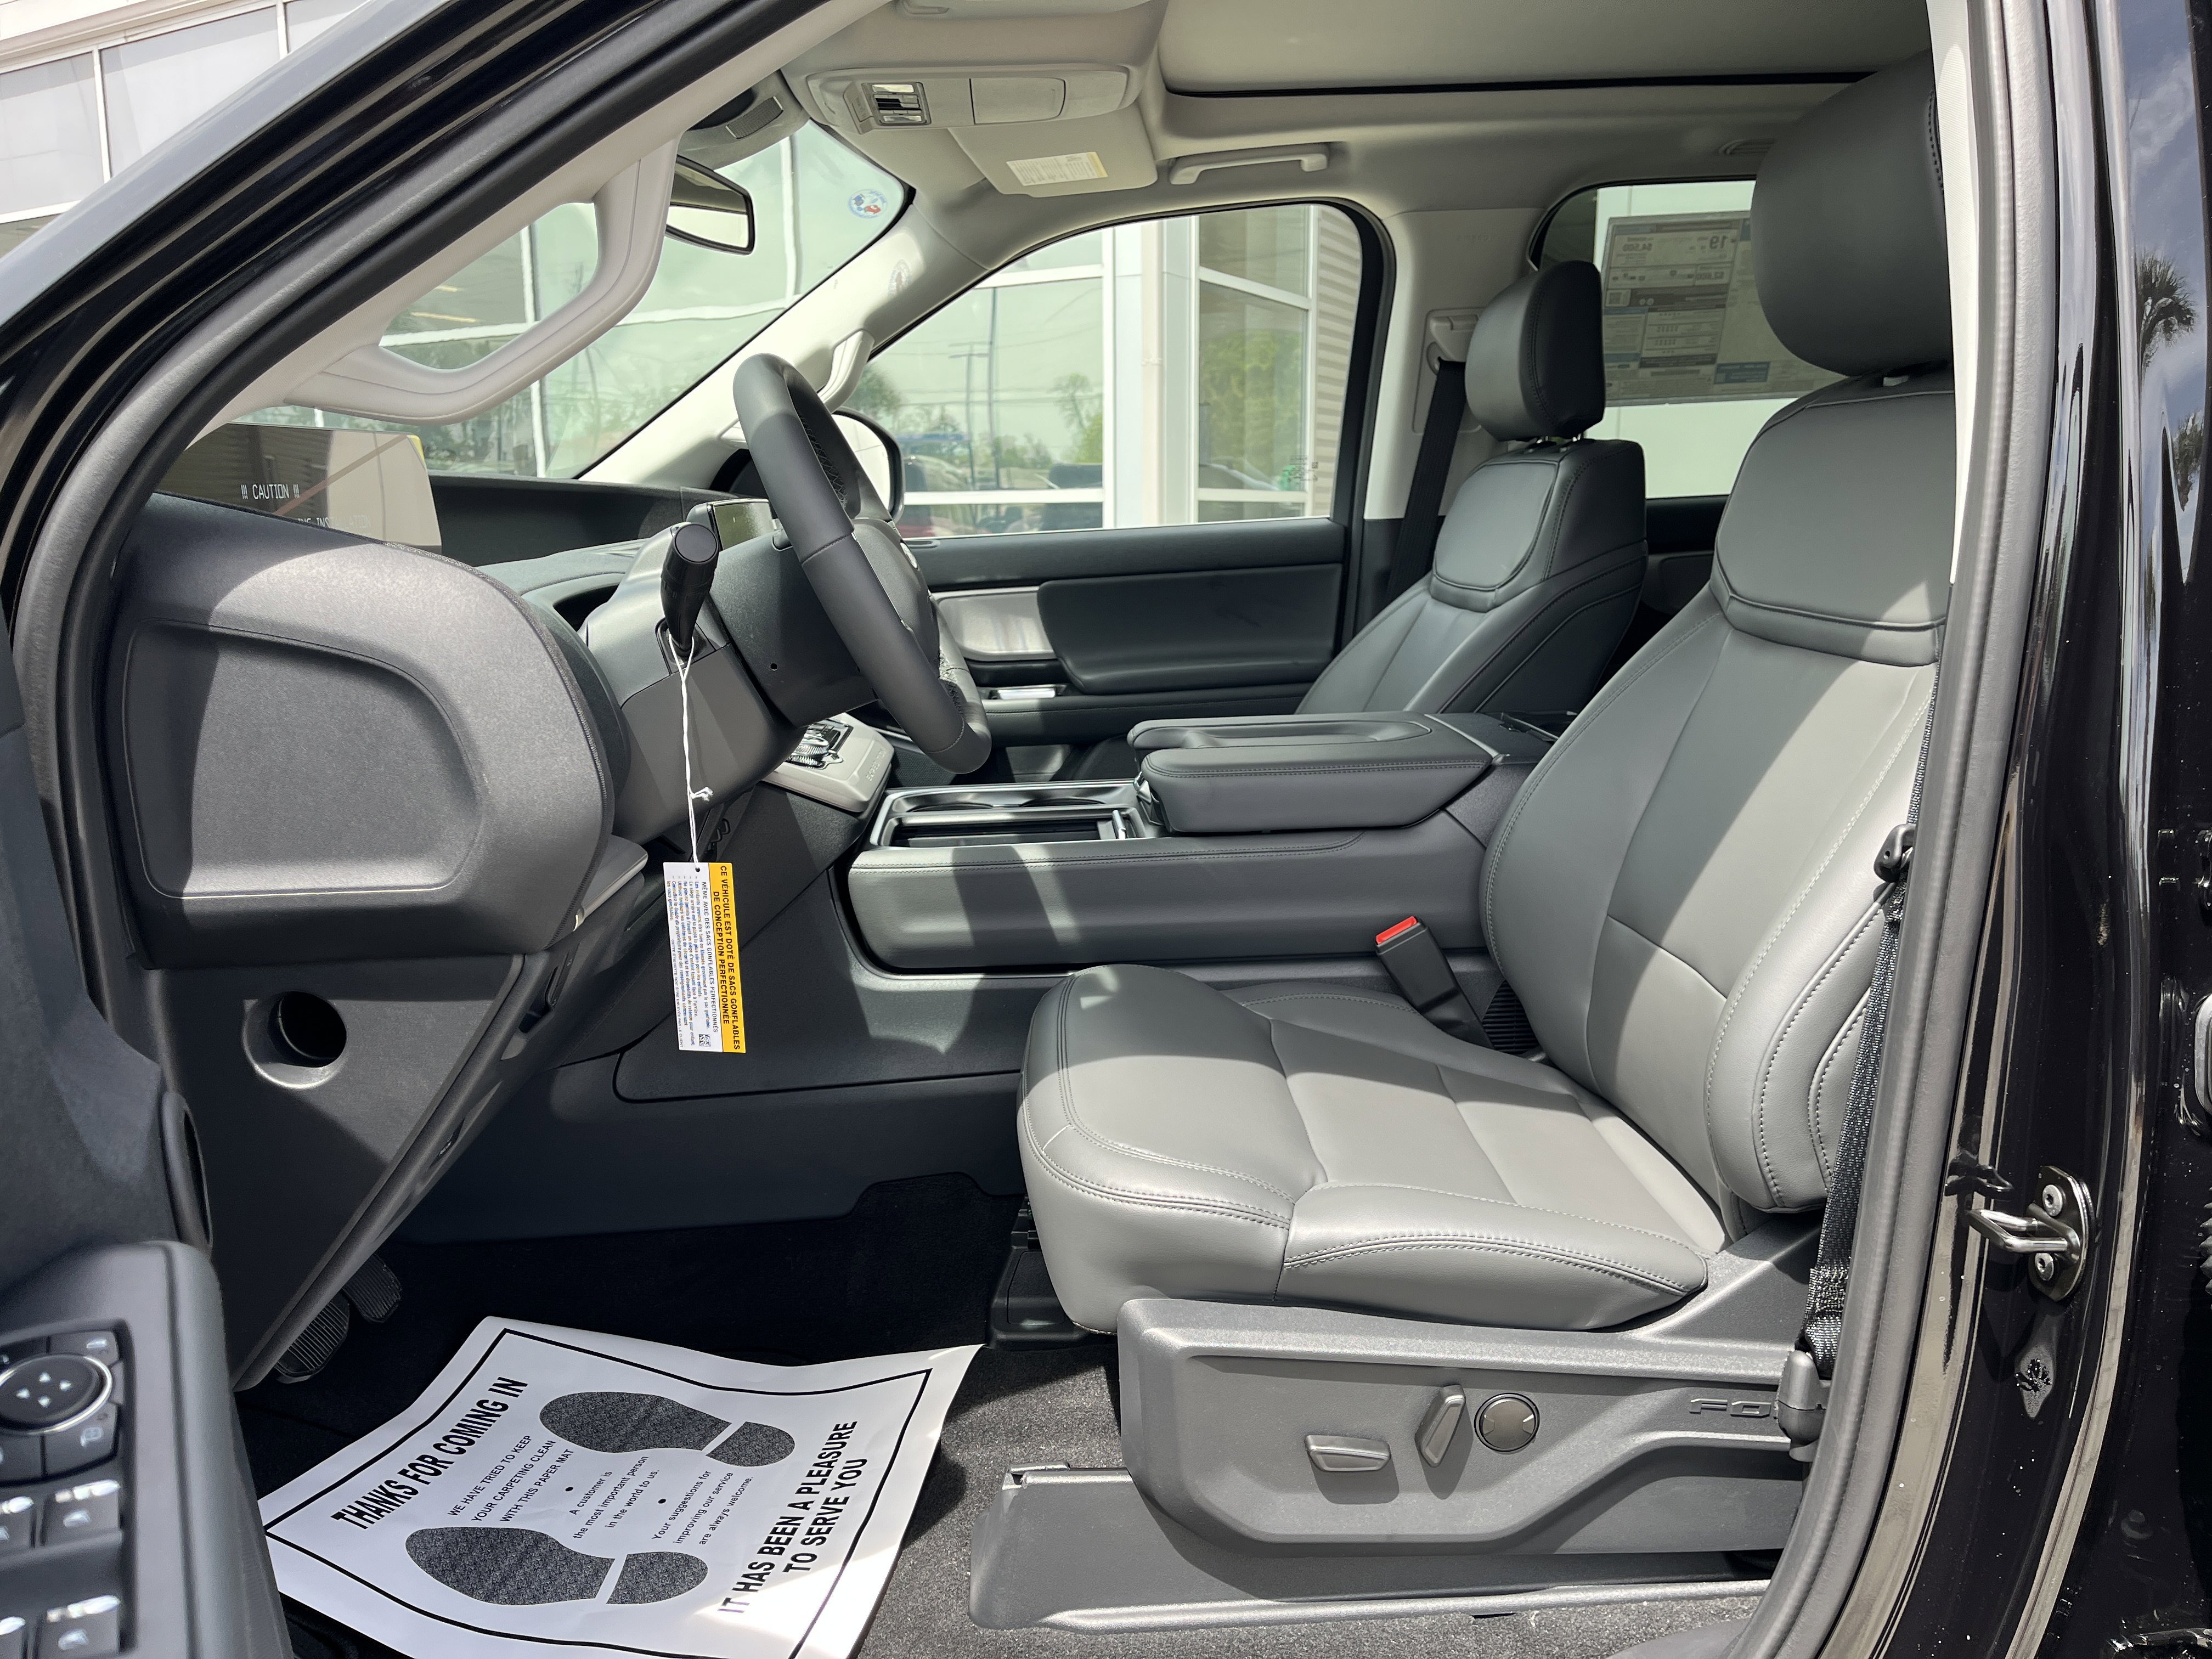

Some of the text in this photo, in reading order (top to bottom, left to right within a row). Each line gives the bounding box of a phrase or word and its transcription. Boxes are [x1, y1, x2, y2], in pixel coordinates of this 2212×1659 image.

[252, 484, 290, 499] CAUTION
[720, 866, 727, 876] CE
[721, 879, 732, 918] VÉHICULE
[713, 891, 731, 1024] DE CONCEPTION PERFECTIONNÉE
[726, 939, 735, 960] DOTÉ
[727, 962, 734, 973] DE
[710, 986, 719, 1032] PERFECTIONNÉS
[730, 998, 740, 1049] GONFLABLES
[330, 1376, 528, 1529] THANKS FOR COMING IN
[447, 1435, 532, 1516] WE HAVE TRIED TO KEEP
[471, 1440, 556, 1521] YOUR CARPETING CLEAN
[500, 1449, 574, 1521] WITH THIS PAPER MAT
[573, 1455, 649, 1538] the most important person
[577, 1477, 606, 1508] customer
[612, 1509, 628, 1520] the
[624, 1488, 644, 1506] world
[647, 1470, 660, 1479] us.
[651, 1470, 712, 1539] Your suggestions for
[673, 1472, 733, 1544] improving our service
[699, 1476, 754, 1545] are always welcome.
[718, 1421, 858, 1613] IT HAS BEEN A PLEASURE
[782, 1459, 868, 1573] TO SERVE YOU
